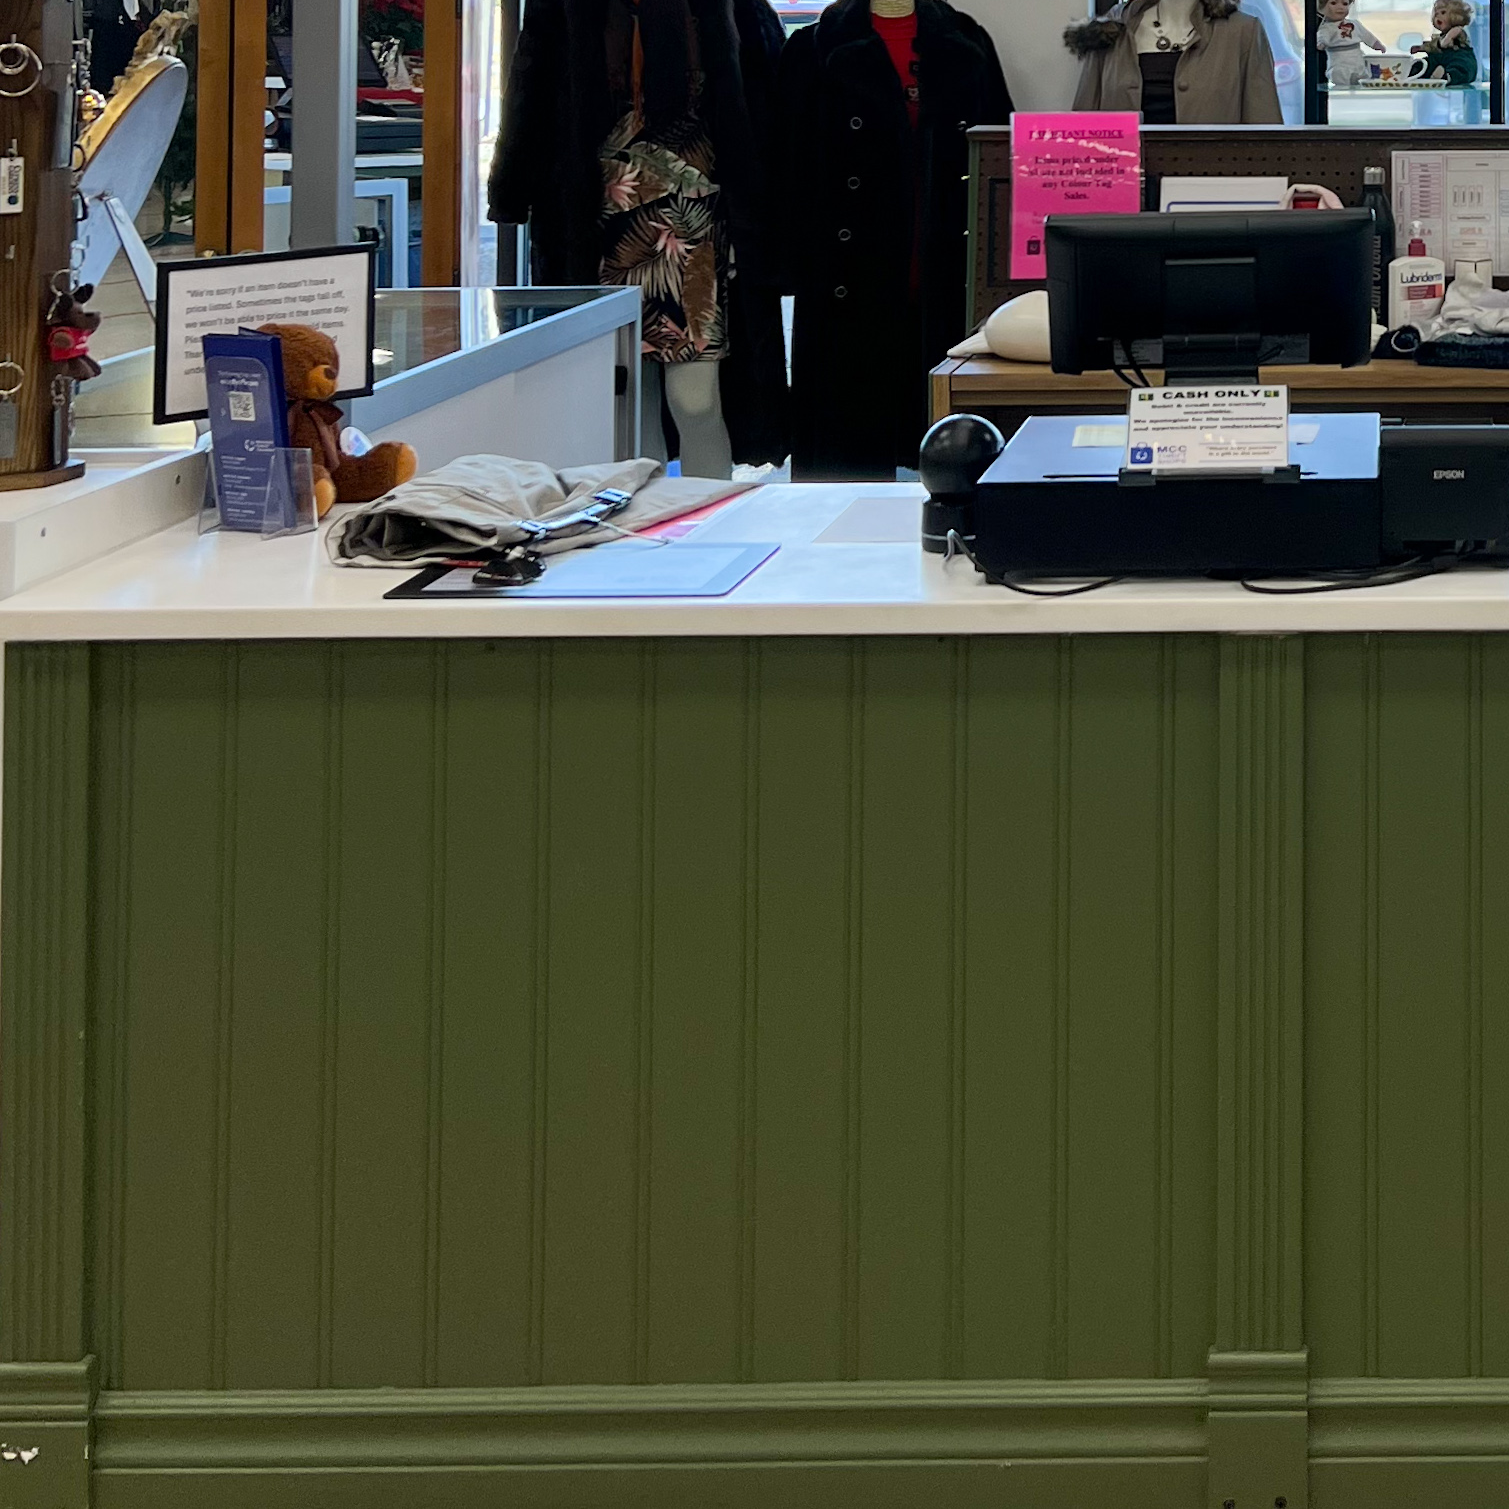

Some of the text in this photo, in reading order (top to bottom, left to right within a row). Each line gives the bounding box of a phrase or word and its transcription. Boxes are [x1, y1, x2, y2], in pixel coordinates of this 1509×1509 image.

[1088, 129, 1124, 138] NOTICE
[1042, 180, 1112, 189] any Colour Tag
[1064, 192, 1089, 200] Sales.
[1400, 271, 1442, 283] Lubriderm
[215, 288, 236, 296] sorry
[277, 280, 307, 289] doesn't
[308, 278, 328, 286] have
[185, 306, 207, 315] price
[208, 302, 234, 311] listed.
[236, 299, 283, 309] Sometimes
[284, 296, 297, 304] the
[298, 294, 316, 303] tags
[199, 319, 222, 328] won't
[224, 317, 235, 325] be
[237, 315, 254, 323] able
[256, 313, 265, 321] to
[266, 312, 287, 322] price
[296, 309, 309, 317] the
[310, 307, 332, 316] same
[1162, 389, 1261, 400] CASH ONLY
[1157, 445, 1187, 453] MCC
[1433, 470, 1464, 479] EPSON
